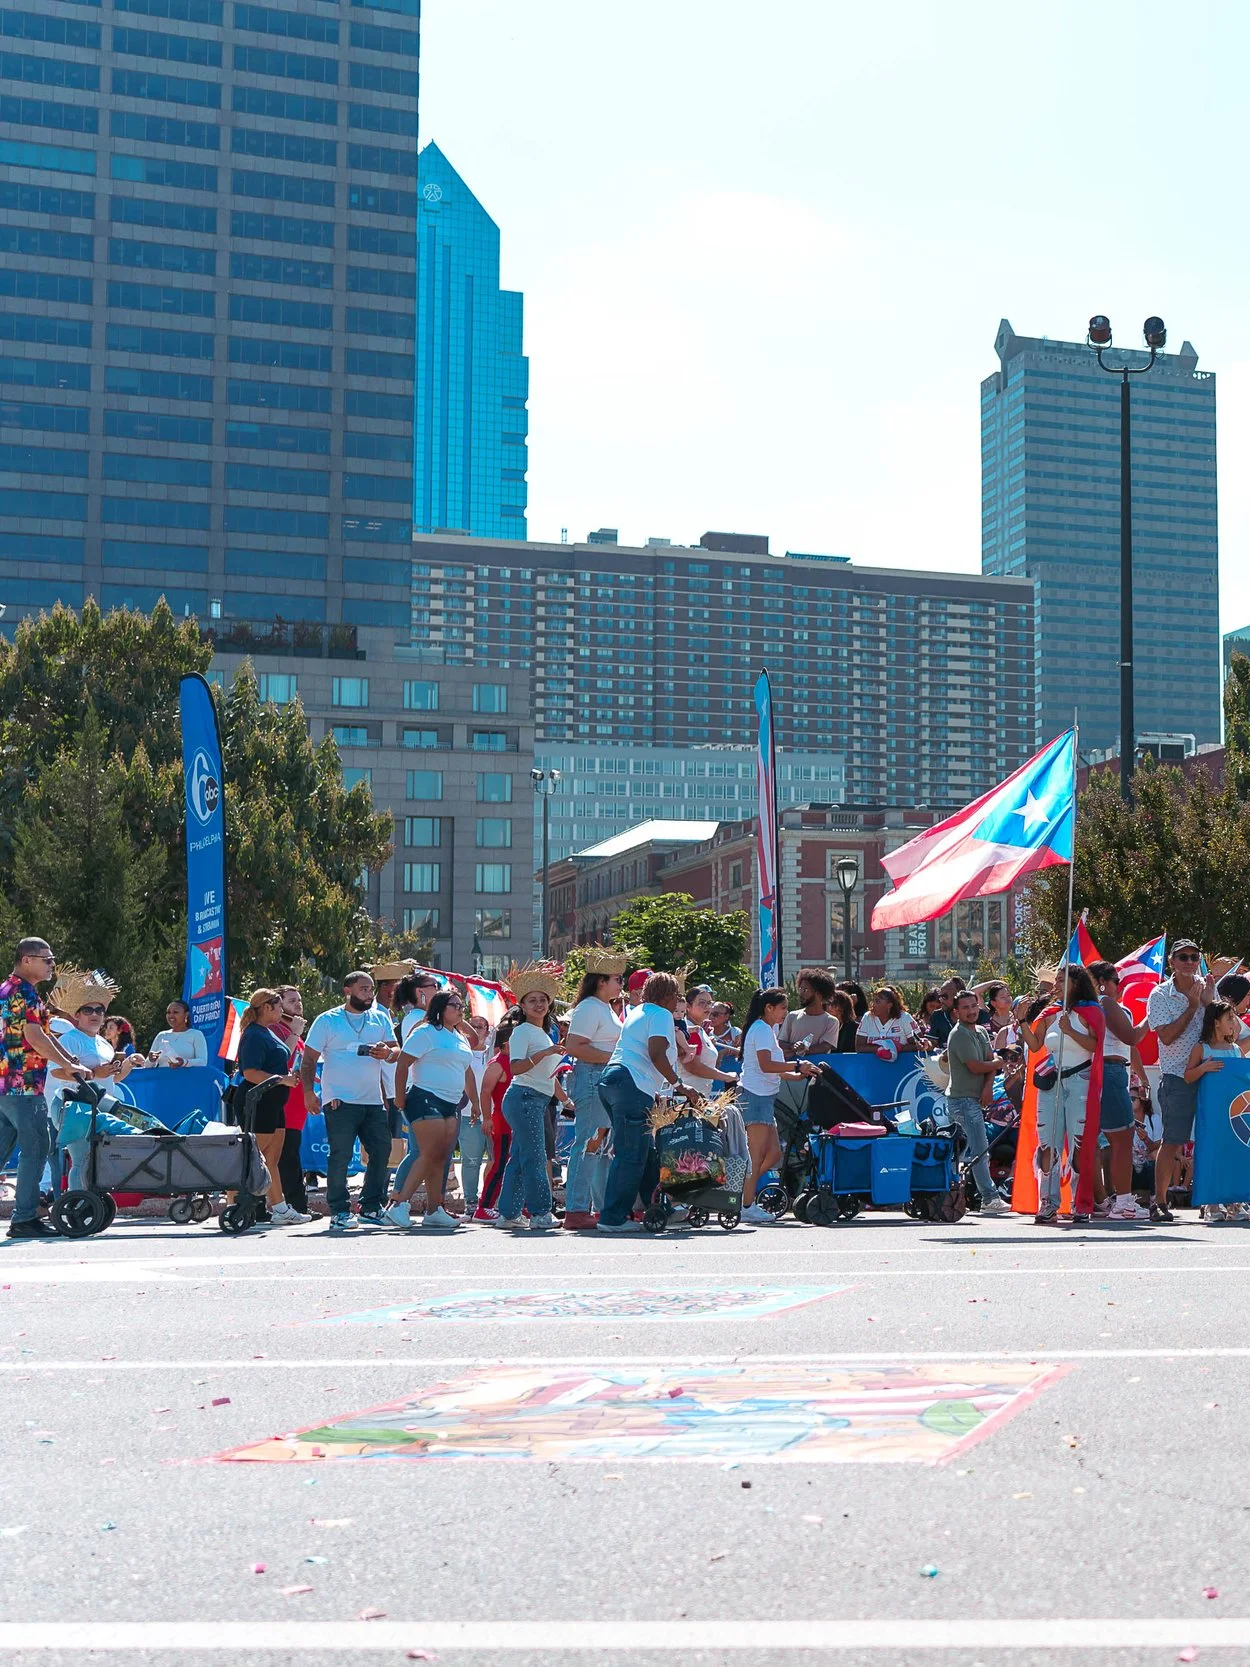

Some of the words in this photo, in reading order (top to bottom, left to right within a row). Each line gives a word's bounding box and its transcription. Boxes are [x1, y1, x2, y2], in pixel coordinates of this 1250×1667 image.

[205, 785, 219, 801] abc
[909, 930, 917, 938] A
[909, 940, 918, 954] BE
[918, 932, 927, 954] FOR
[933, 1103, 949, 1117] ab
